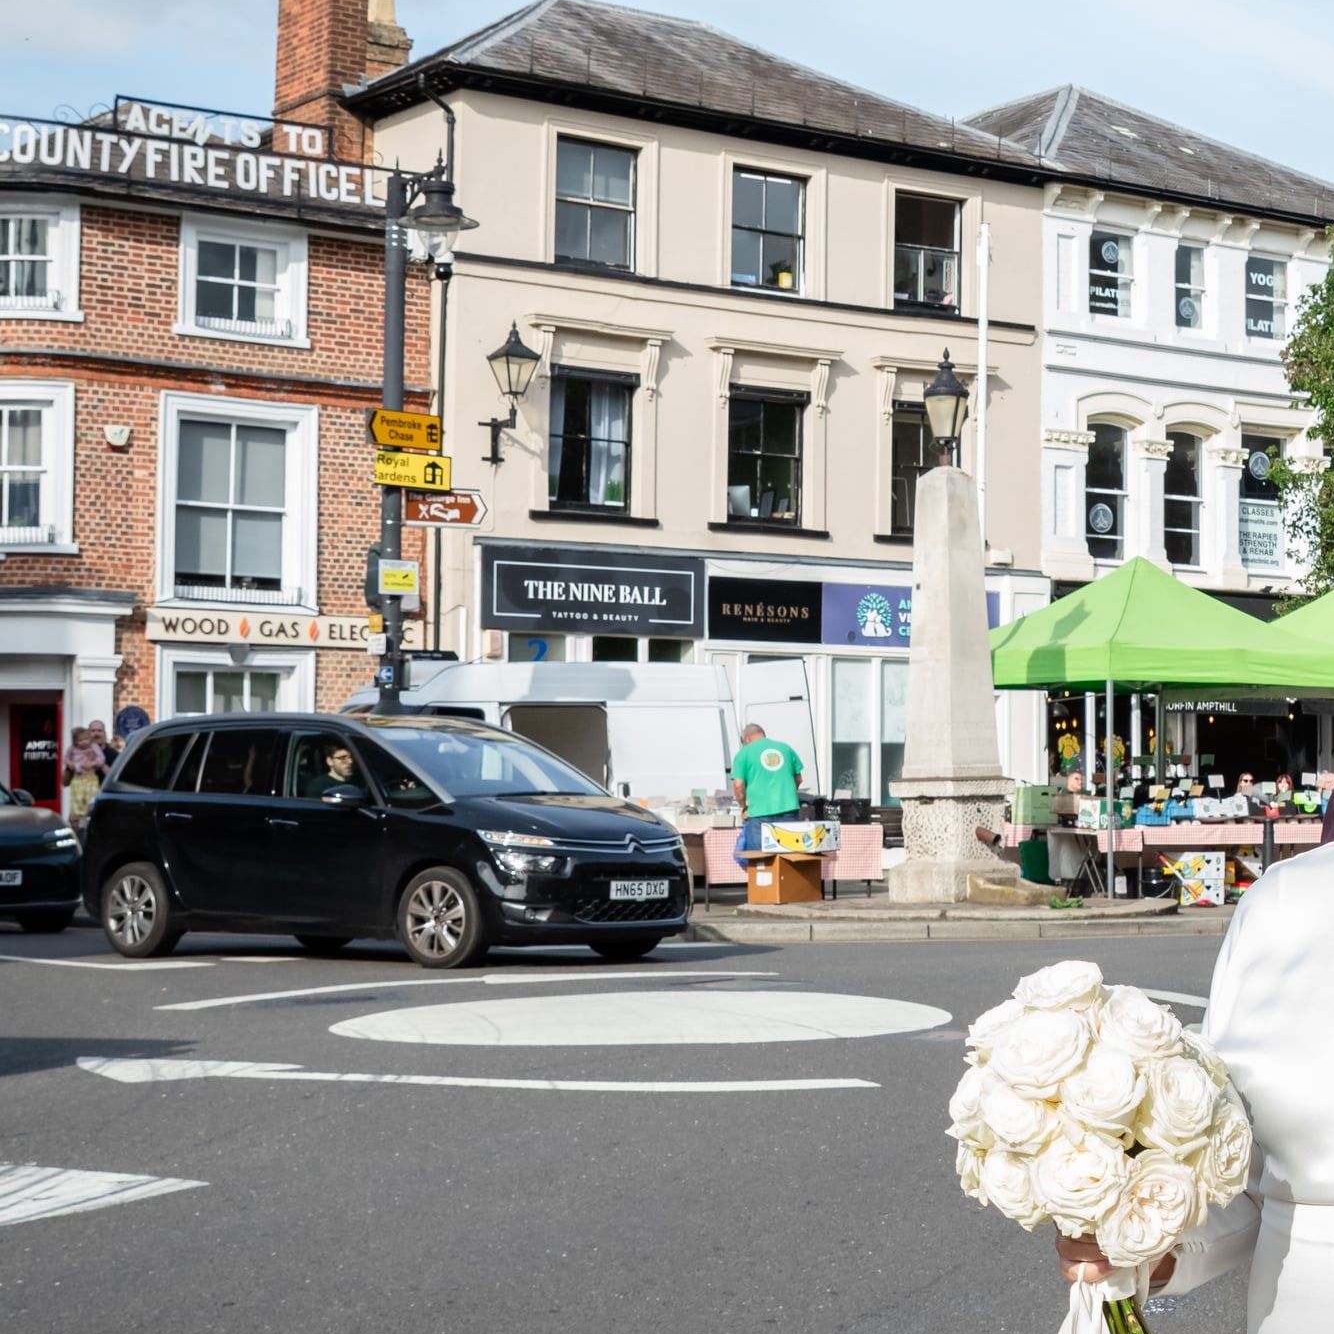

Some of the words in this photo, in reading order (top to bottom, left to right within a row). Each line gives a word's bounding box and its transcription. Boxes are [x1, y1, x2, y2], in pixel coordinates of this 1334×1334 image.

[126, 103, 261, 148] AGENTS
[282, 125, 323, 155] TO
[146, 139, 229, 189] FIRE
[235, 152, 362, 204] OFFICE
[381, 415, 422, 430] Pembroke
[388, 429, 414, 442] Chase
[377, 454, 409, 468] Royal
[457, 495, 471, 504] Inn
[1239, 531, 1278, 541] THERAPIES
[1239, 538, 1277, 548] STRENGTH
[1250, 548, 1274, 556] REHAB
[523, 580, 566, 601] THE
[568, 582, 616, 604] NINE
[618, 584, 667, 606] BALL
[551, 611, 589, 620] TATTOO
[592, 613, 599, 621] &
[602, 613, 640, 622] BEAUTY
[721, 601, 809, 619] RENÉSONS
[161, 616, 230, 636] WOOD
[259, 620, 300, 638] GAS
[1196, 701, 1238, 712] AMPTHILL
[615, 883, 644, 897] HN65
[645, 882, 665, 896] DXG
